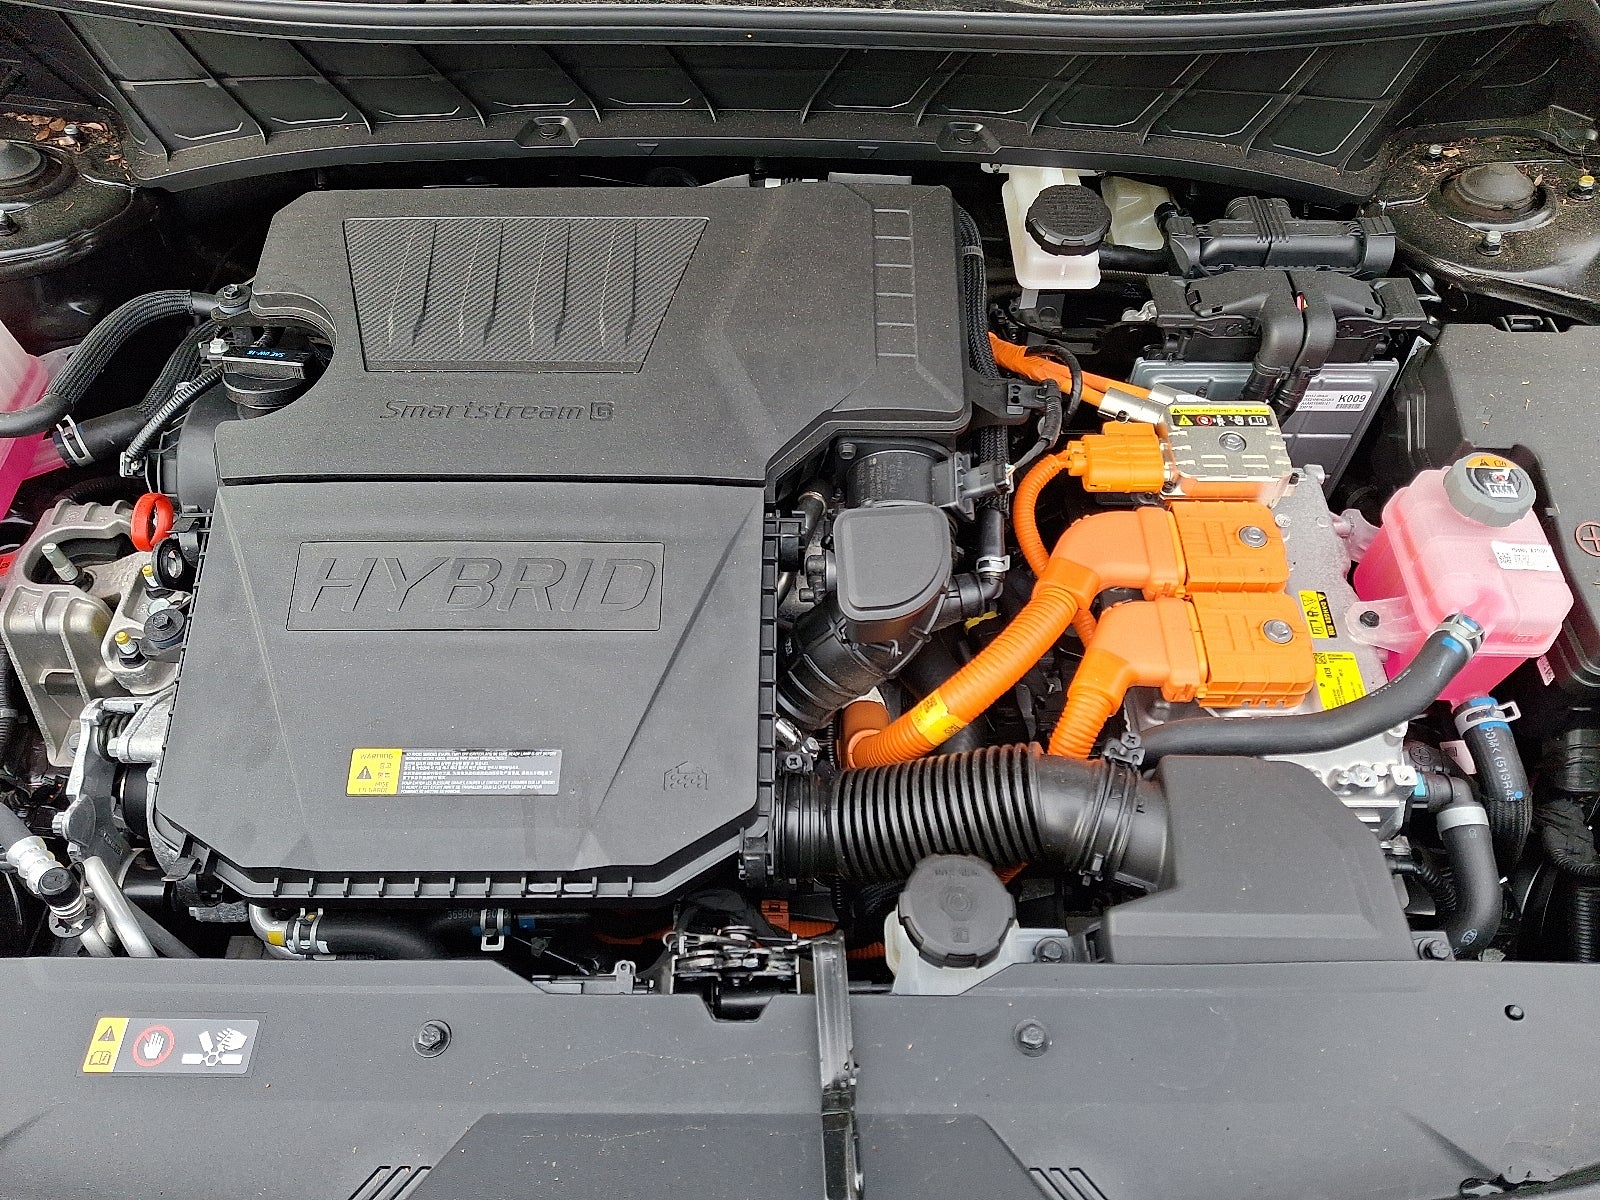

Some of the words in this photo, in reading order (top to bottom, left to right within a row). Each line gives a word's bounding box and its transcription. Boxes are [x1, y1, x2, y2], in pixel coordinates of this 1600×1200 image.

[1338, 394, 1367, 403] K009
[380, 399, 584, 420] Smartstream
[298, 556, 657, 613] HYBRID
